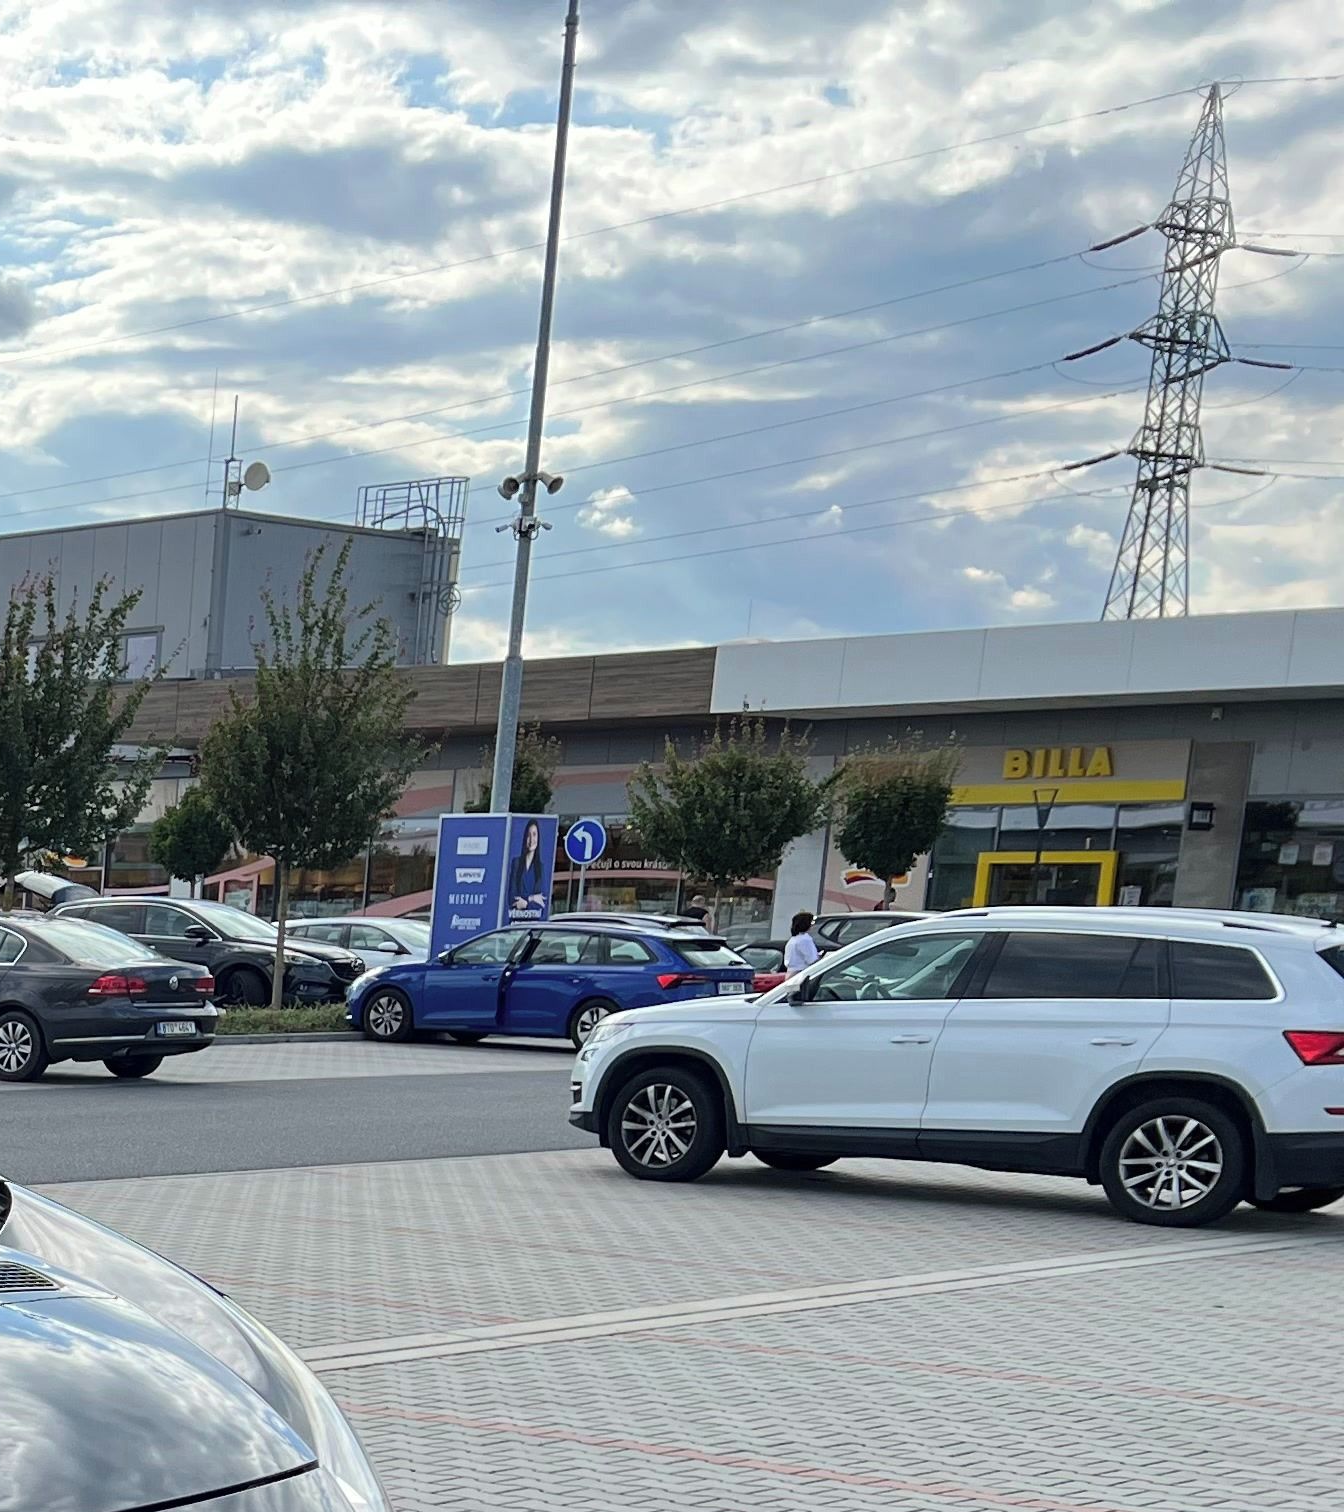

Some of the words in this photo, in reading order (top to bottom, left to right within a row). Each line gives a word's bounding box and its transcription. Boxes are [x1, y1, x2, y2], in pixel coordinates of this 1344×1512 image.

[1003, 747, 1111, 779] BILLA
[621, 860, 642, 869] svou
[449, 893, 484, 905] MUSTANG
